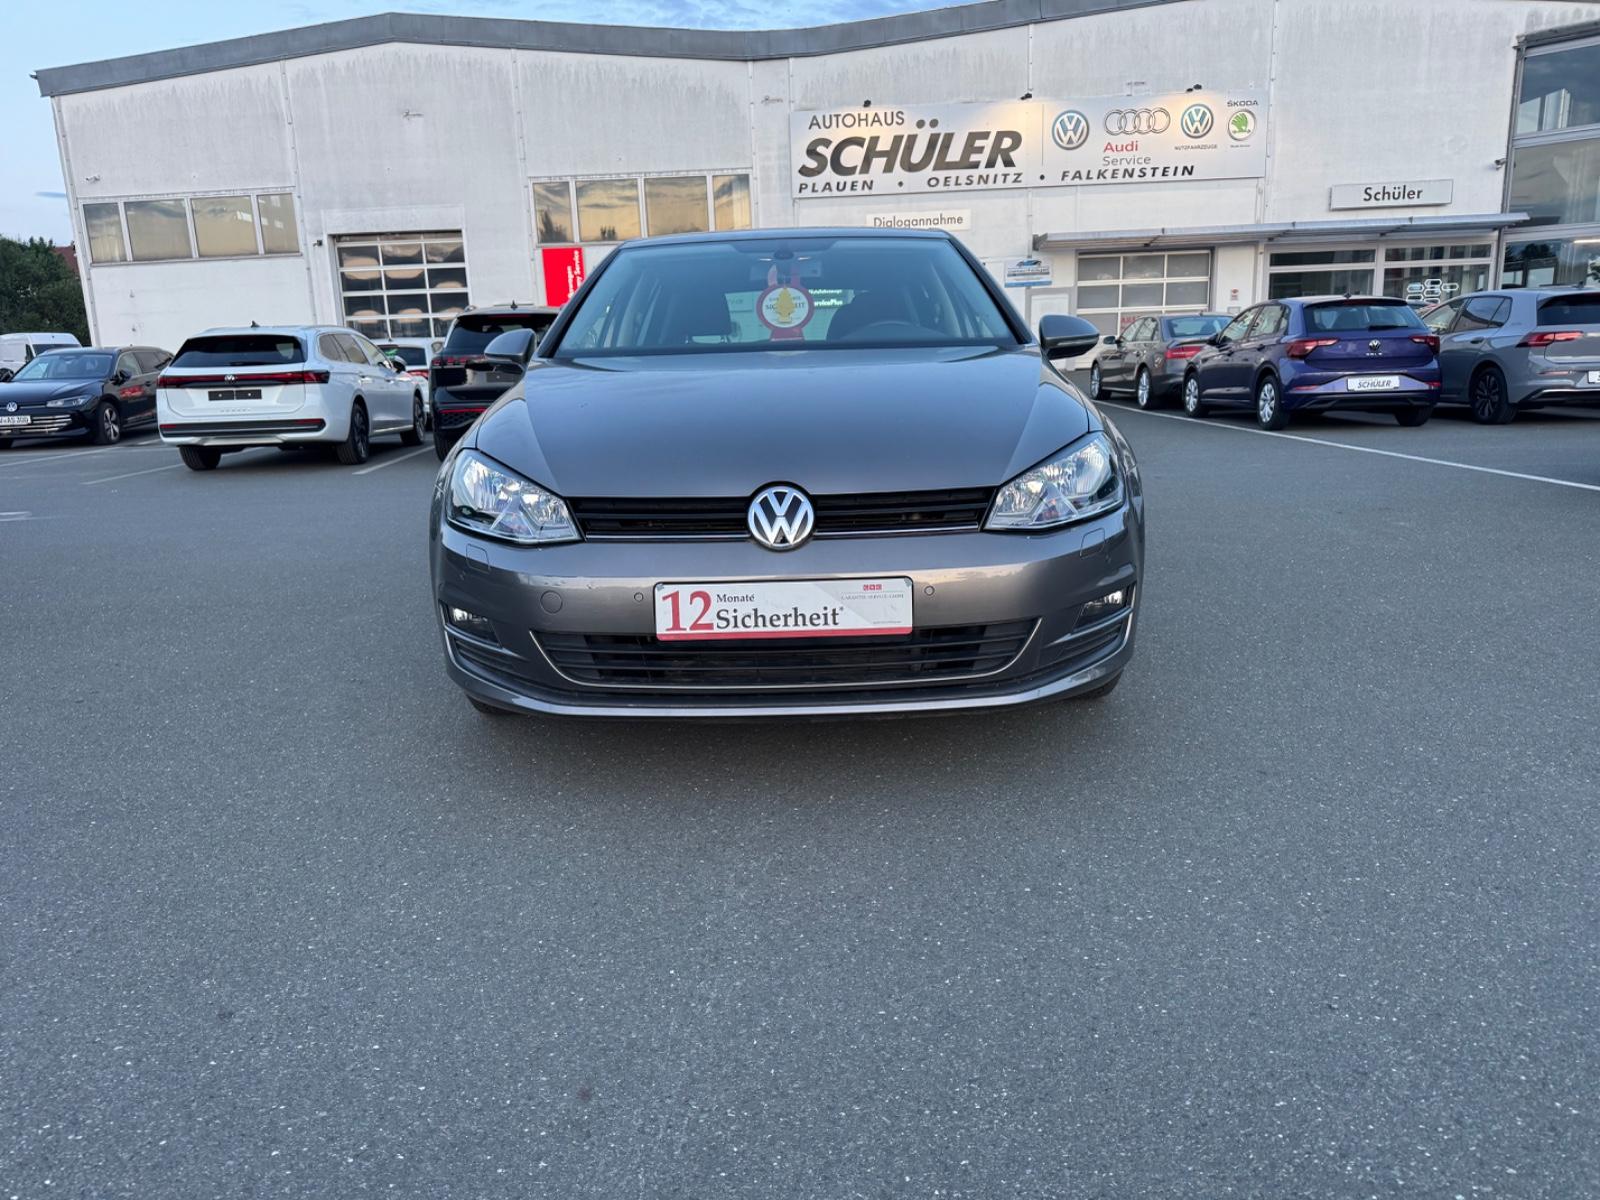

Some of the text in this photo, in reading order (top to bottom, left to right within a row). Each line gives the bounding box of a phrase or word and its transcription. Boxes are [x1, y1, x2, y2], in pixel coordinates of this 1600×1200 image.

[808, 110, 905, 130] AUTOHAUS
[798, 118, 1023, 177] SCHÜLER
[1103, 140, 1139, 153] Audi
[1102, 155, 1152, 167] Service
[798, 165, 1195, 194] PLAUEN OELSNITZ FALKENSTEIN
[1363, 185, 1423, 202] Schüler
[873, 213, 964, 229] Dialogannahme
[662, 590, 714, 631] 12
